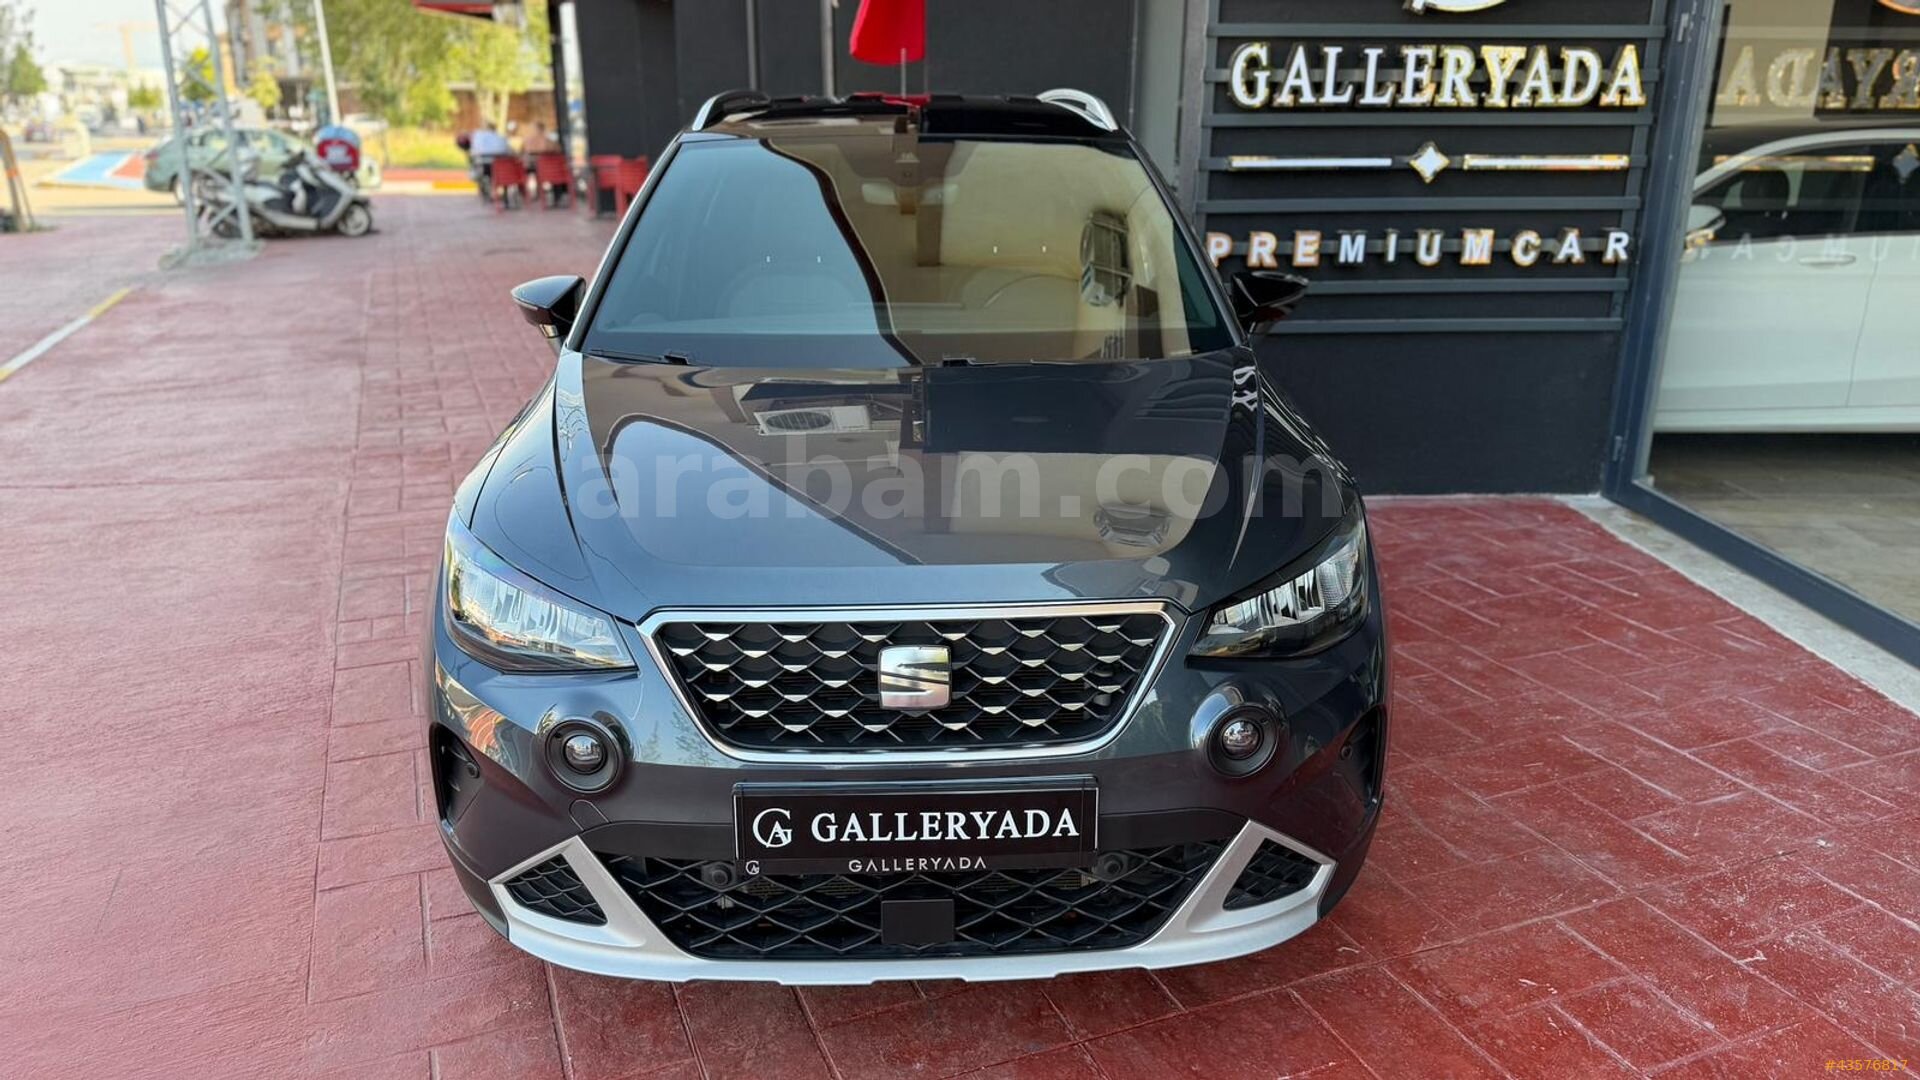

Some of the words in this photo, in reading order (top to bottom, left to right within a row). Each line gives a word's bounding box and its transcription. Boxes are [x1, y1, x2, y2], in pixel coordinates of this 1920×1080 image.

[1229, 43, 1646, 107] GALLERYADA
[812, 808, 1080, 842] GALLERYADA
[848, 856, 987, 873] GALLERYADA
